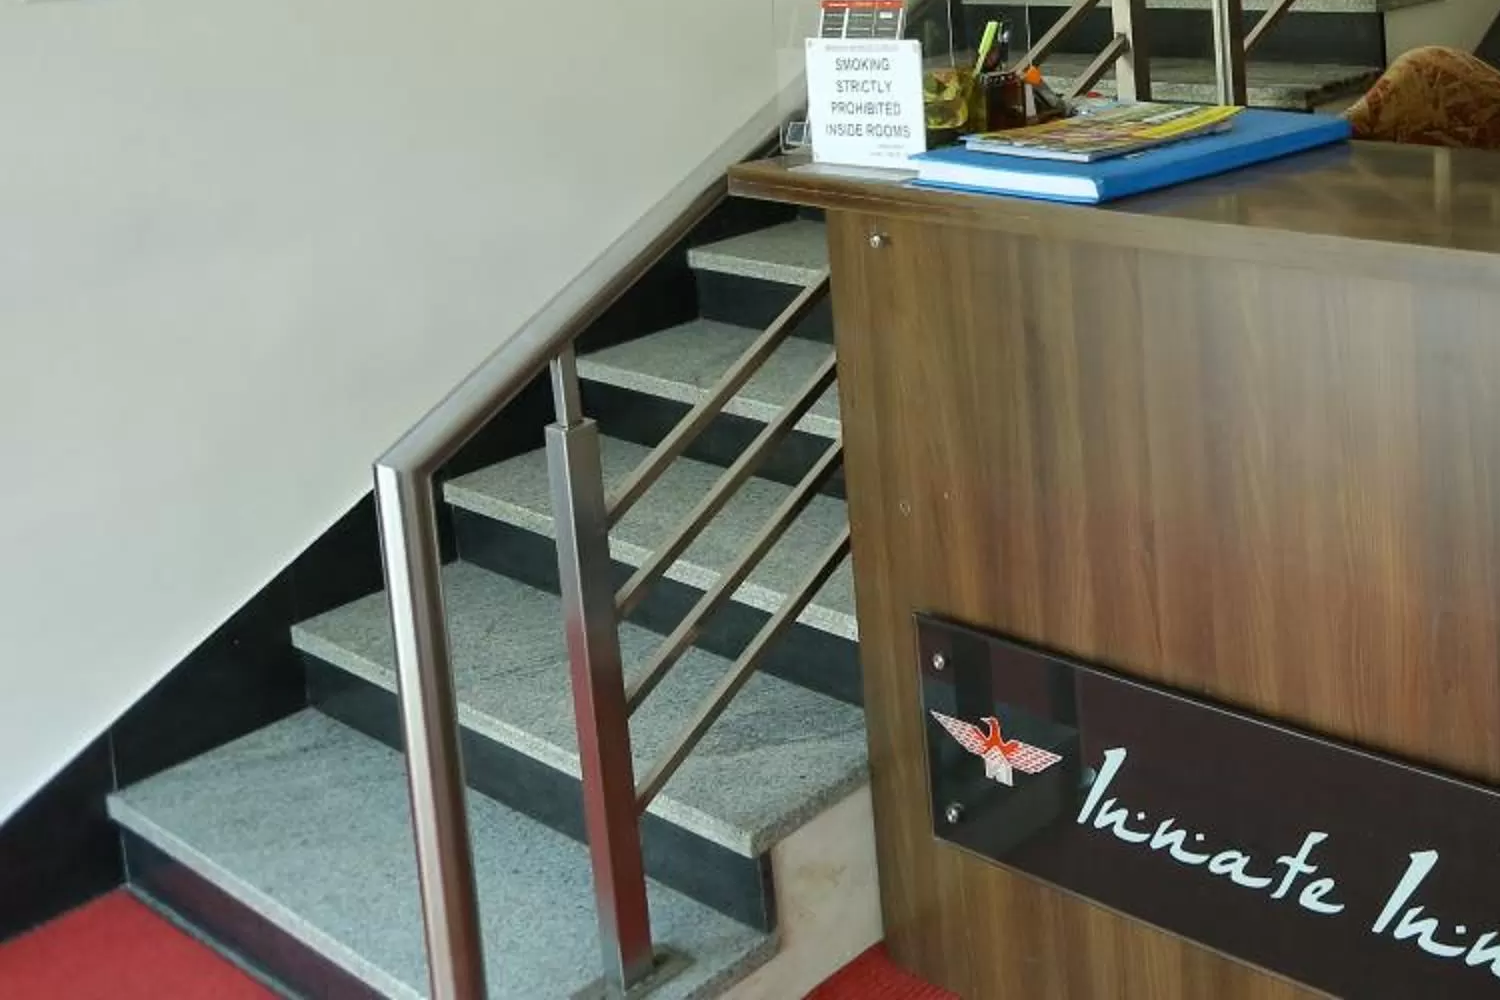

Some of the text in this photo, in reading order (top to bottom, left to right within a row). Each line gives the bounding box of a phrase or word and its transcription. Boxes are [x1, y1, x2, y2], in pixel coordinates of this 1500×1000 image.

[835, 57, 890, 71] SMOKING
[835, 79, 892, 93] STRICTLY
[831, 101, 901, 116] PROHIBITED
[825, 123, 911, 139] INSIDE ROOMS
[1077, 747, 1345, 914] Innate
